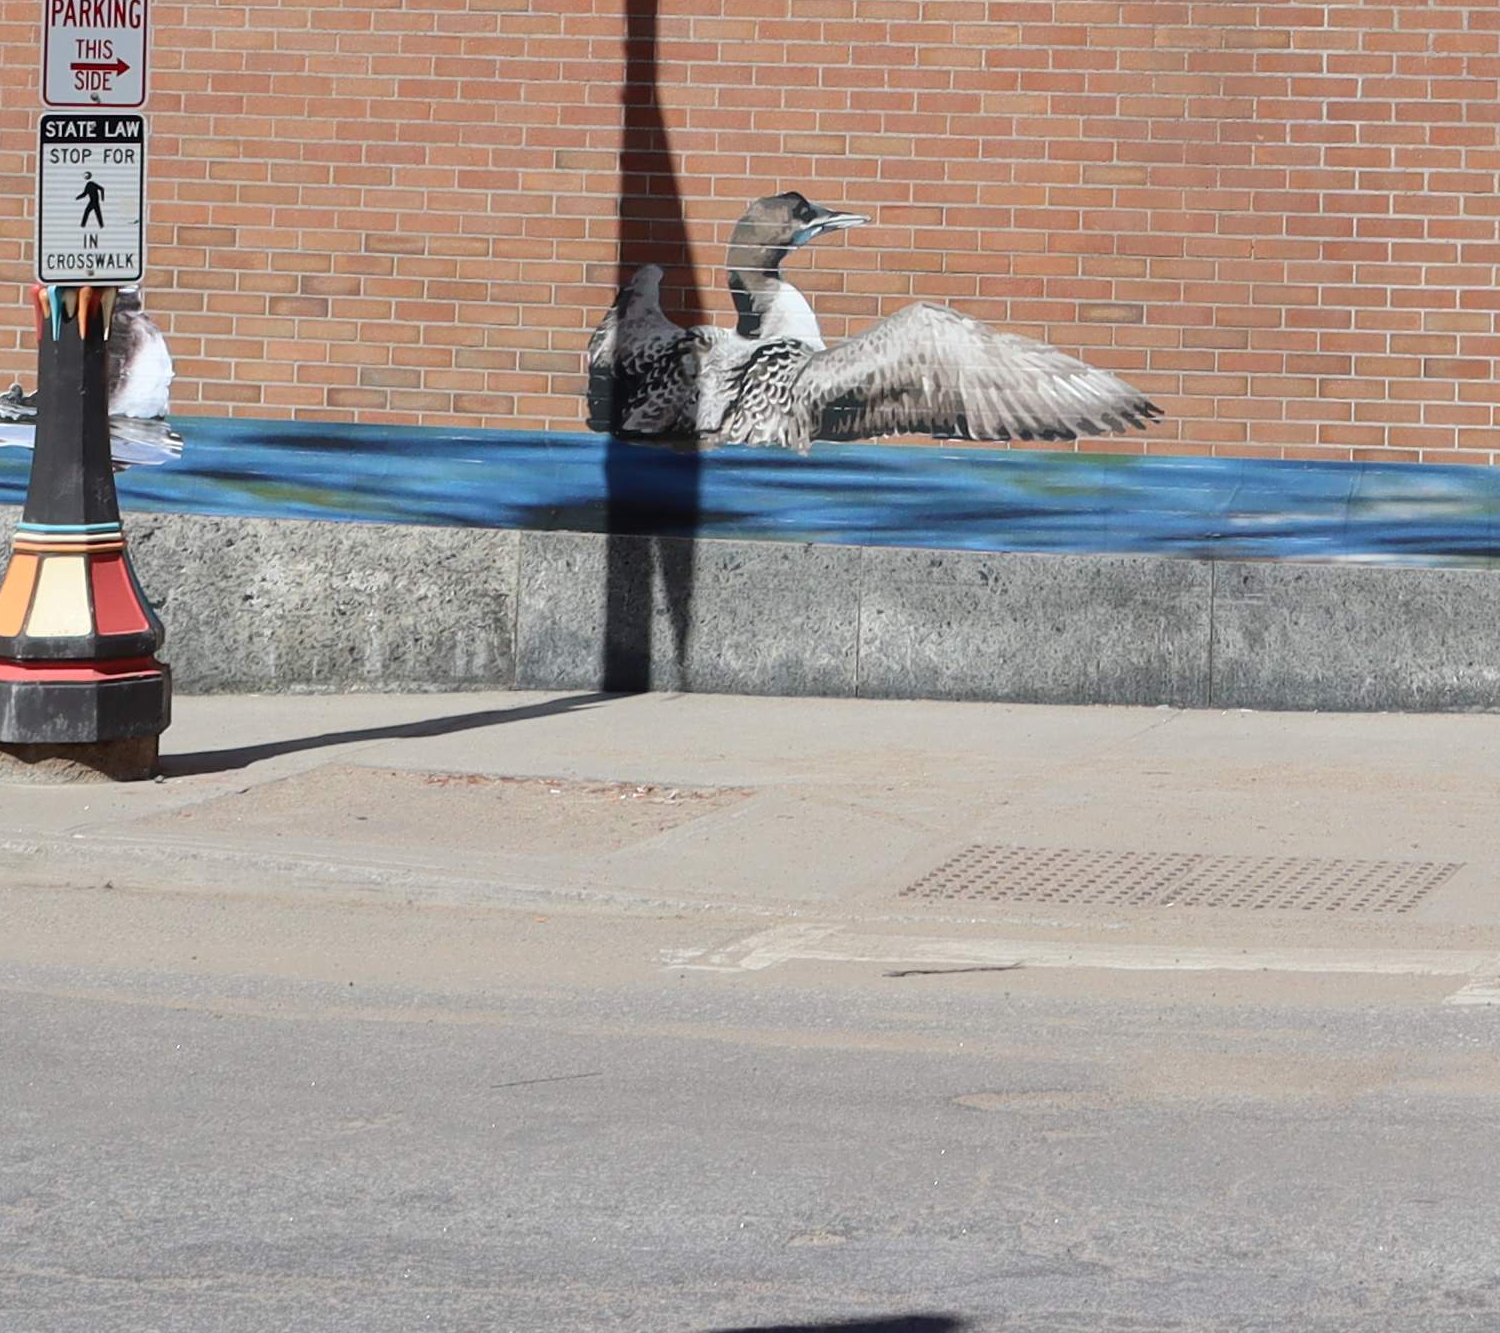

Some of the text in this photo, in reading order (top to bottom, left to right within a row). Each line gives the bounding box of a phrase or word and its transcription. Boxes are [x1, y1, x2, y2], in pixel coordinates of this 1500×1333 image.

[75, 39, 113, 60] THIS
[74, 71, 112, 92] SIDE
[45, 120, 140, 139] STATE LAW
[50, 148, 136, 165] STOP FOR
[83, 233, 99, 249] IN
[47, 252, 134, 270] CROSSWALK
